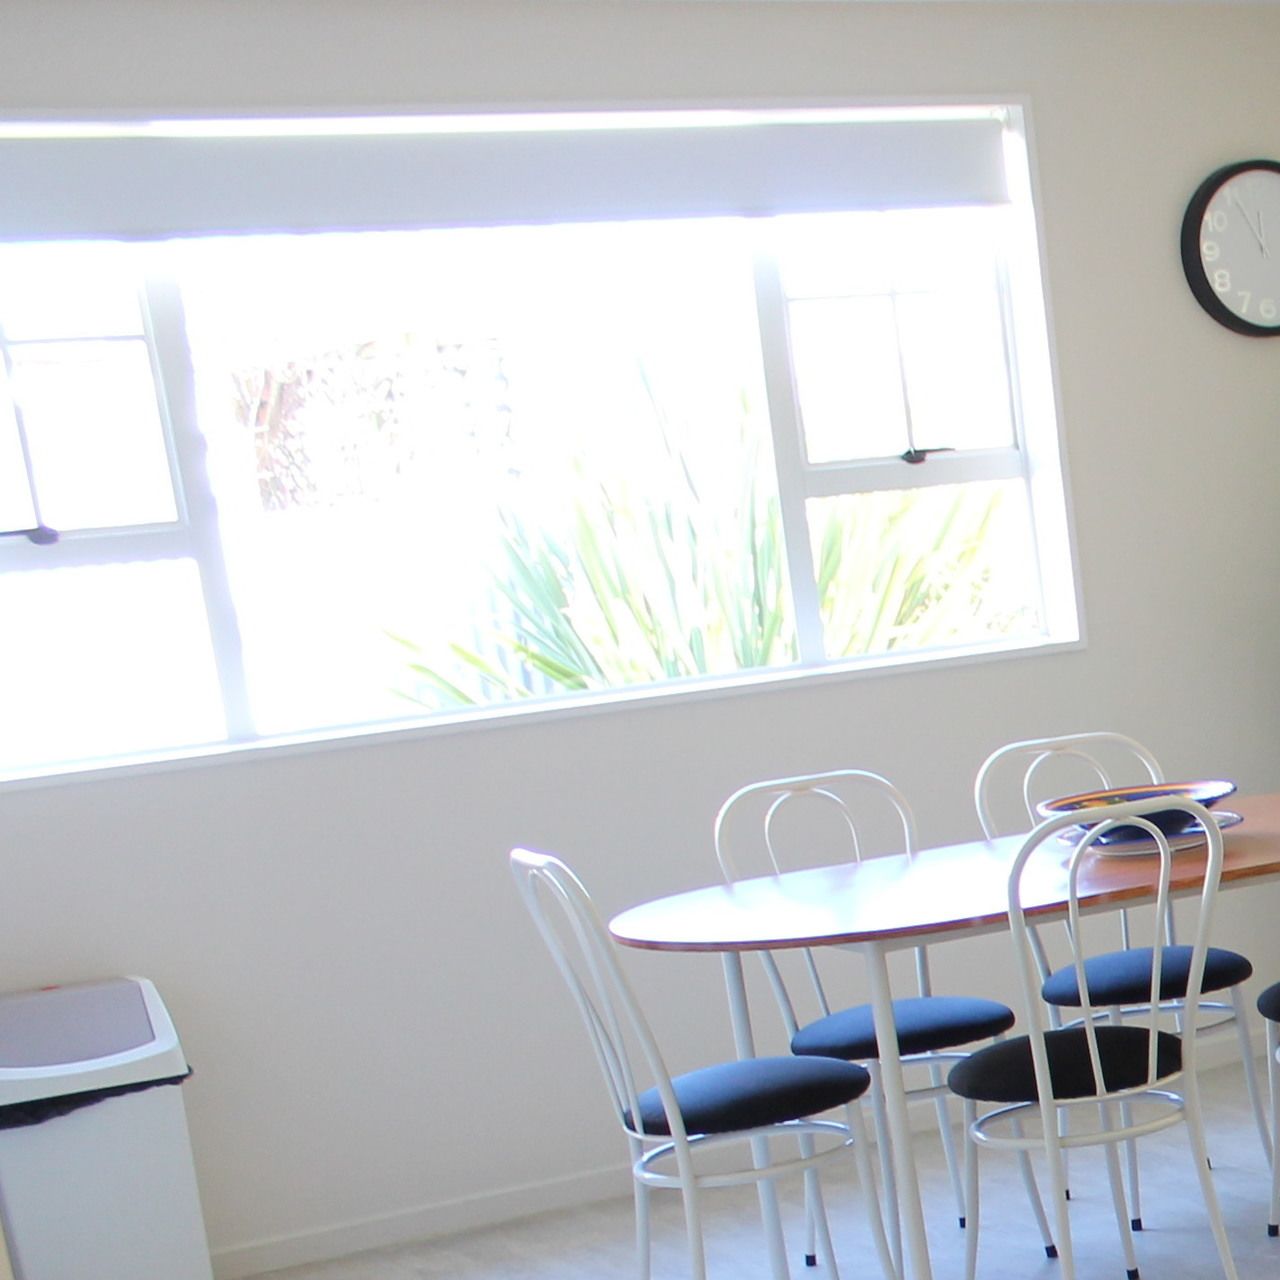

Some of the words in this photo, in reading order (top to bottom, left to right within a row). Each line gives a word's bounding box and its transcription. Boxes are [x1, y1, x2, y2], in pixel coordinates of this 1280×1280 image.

[1204, 210, 1228, 232] 10
[1202, 240, 1221, 262] 9
[1214, 269, 1231, 292] 8
[1237, 290, 1252, 313] 7
[1259, 297, 1277, 319] 6
